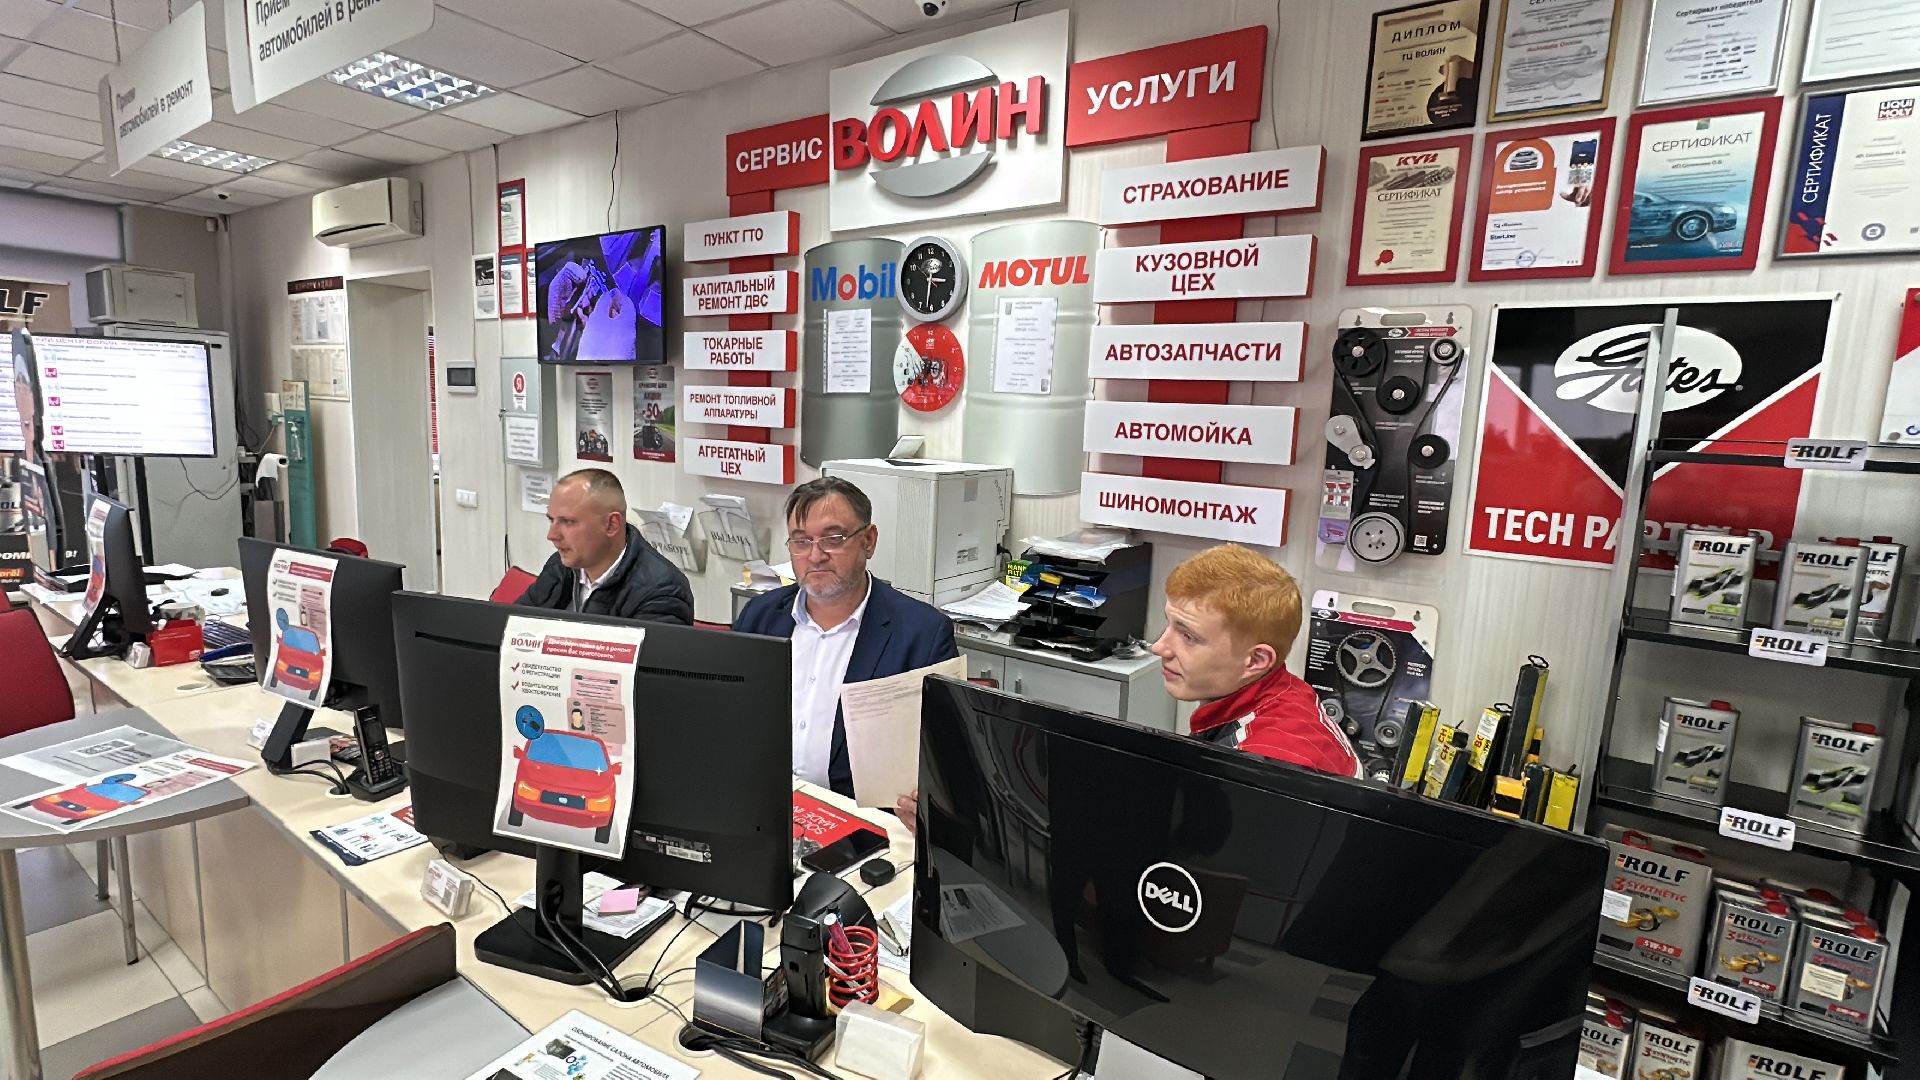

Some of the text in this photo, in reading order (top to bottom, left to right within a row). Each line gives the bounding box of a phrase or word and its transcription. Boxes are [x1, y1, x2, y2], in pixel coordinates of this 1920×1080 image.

[259, 2, 333, 61] автомобилей
[336, 1, 345, 22] в
[1392, 20, 1461, 43] ДИПЛОМ
[1086, 60, 1236, 115] УСЛУГИ
[120, 97, 159, 138] автомобилей
[166, 80, 193, 112] ремонт
[1879, 108, 1912, 118] MOLY
[1880, 100, 1914, 110] LIQUI
[833, 75, 1045, 171] ВОЛИН
[1652, 132, 1752, 153] СЕРТИФИКАТ
[736, 137, 823, 173] СЕРВИС
[1802, 113, 1832, 203] СЕРТИФИКАТ
[1123, 169, 1289, 204] СТРАХОВАНИЕ
[1377, 187, 1443, 202] СЕРТИФИКАТ
[704, 228, 764, 247] ПУНКТ ГТО
[1135, 243, 1260, 273] КУЗОВНОЙ
[812, 262, 896, 301] Mobil
[978, 255, 1090, 289] MOTUL
[692, 274, 775, 296] КАПИТАЛЬНЫЙ
[1171, 273, 1216, 295] ЦЕХ
[698, 294, 769, 310] РЕМОНТ ДВС
[703, 337, 763, 350] ТОКАРНЫЕ
[1105, 343, 1282, 362] АВТОЗАПЧАСТИ
[710, 352, 755, 365] РАБОТЫ
[690, 393, 776, 406] РЕМОНТ ТОПЛИВНОЙ
[704, 408, 758, 419] АППАРАТУРЫ
[1114, 422, 1252, 446] АВТОМОЙКА
[699, 445, 766, 462] АГРЕГАТНЫЙ
[1799, 444, 1863, 460] ROLF
[720, 461, 742, 475] ЦЕХ
[1099, 491, 1258, 525] ШИНОМОНТАЖ
[1484, 507, 1574, 548] TECH
[1700, 540, 1750, 555] ROLF
[1802, 552, 1857, 567] ROLF
[510, 637, 542, 648] ВОЛИН
[1761, 636, 1826, 654] ROLF
[1681, 715, 1730, 731] ROLF
[1819, 734, 1875, 754] ROLF
[1731, 815, 1791, 839] ROLF
[1624, 855, 1691, 883] ROLF
[1145, 881, 1194, 914] DELL
[1734, 914, 1786, 936] ROLF
[1820, 938, 1877, 961] ROLF
[1700, 986, 1756, 1011] ROLF
[1581, 1027, 1623, 1047] ROLF
[1650, 1033, 1696, 1054] ROLF
[1756, 1056, 1827, 1080] ROLF
